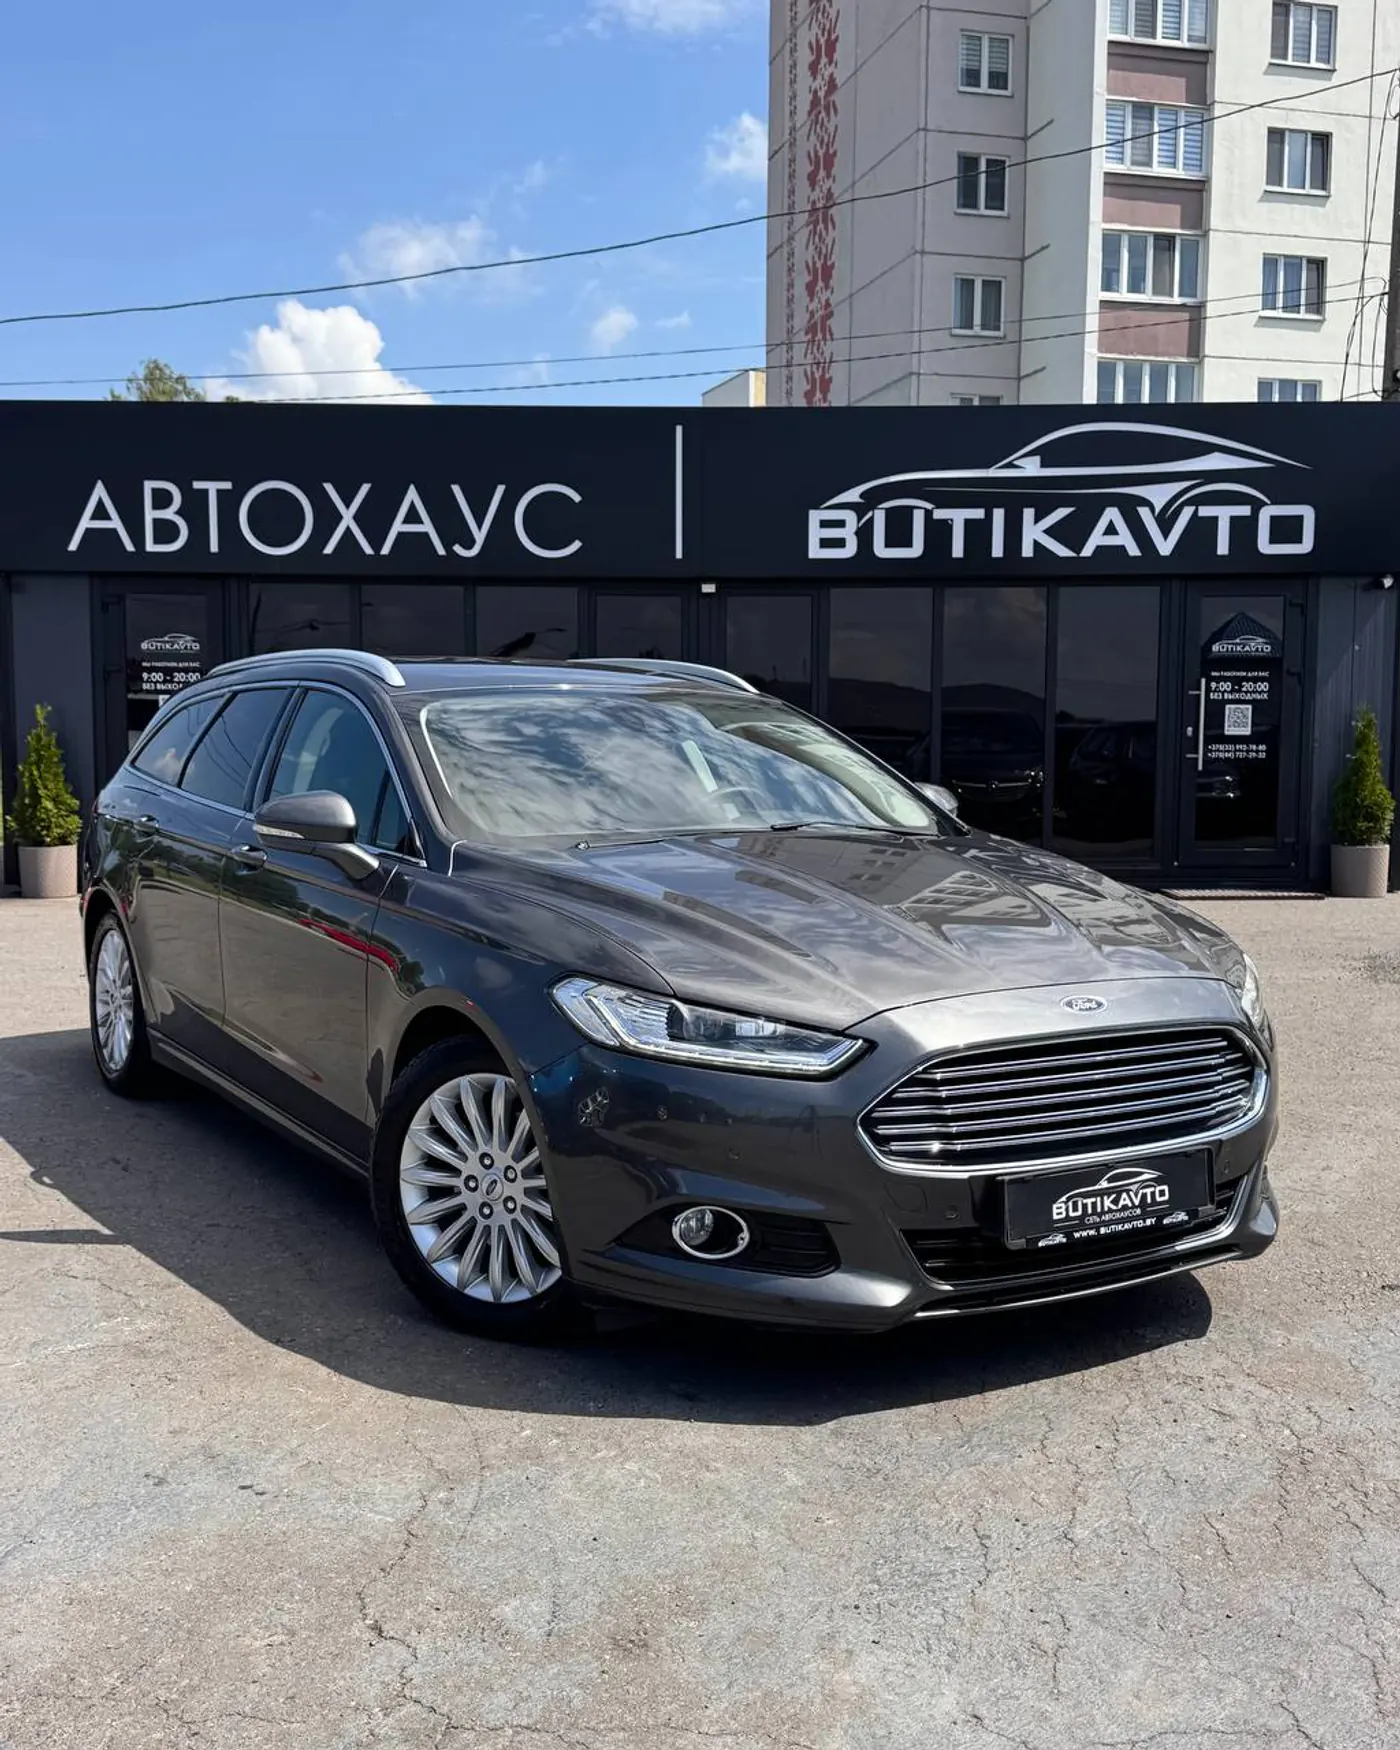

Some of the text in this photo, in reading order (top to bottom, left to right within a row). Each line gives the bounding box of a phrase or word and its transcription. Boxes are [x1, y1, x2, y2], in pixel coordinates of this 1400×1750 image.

[67, 479, 583, 558] АВТОХАУС
[807, 504, 1316, 560] BUTIKAVTO
[1212, 644, 1271, 652] BUTIKAVTO
[142, 672, 164, 682] 9:00
[172, 672, 201, 682] 20:00
[1210, 682, 1232, 691] 9:00
[1241, 682, 1269, 691] 20:00
[1052, 1185, 1170, 1220] BUTIKAVTO
[1099, 1217, 1157, 1235] BUTIKAVTO.BY
